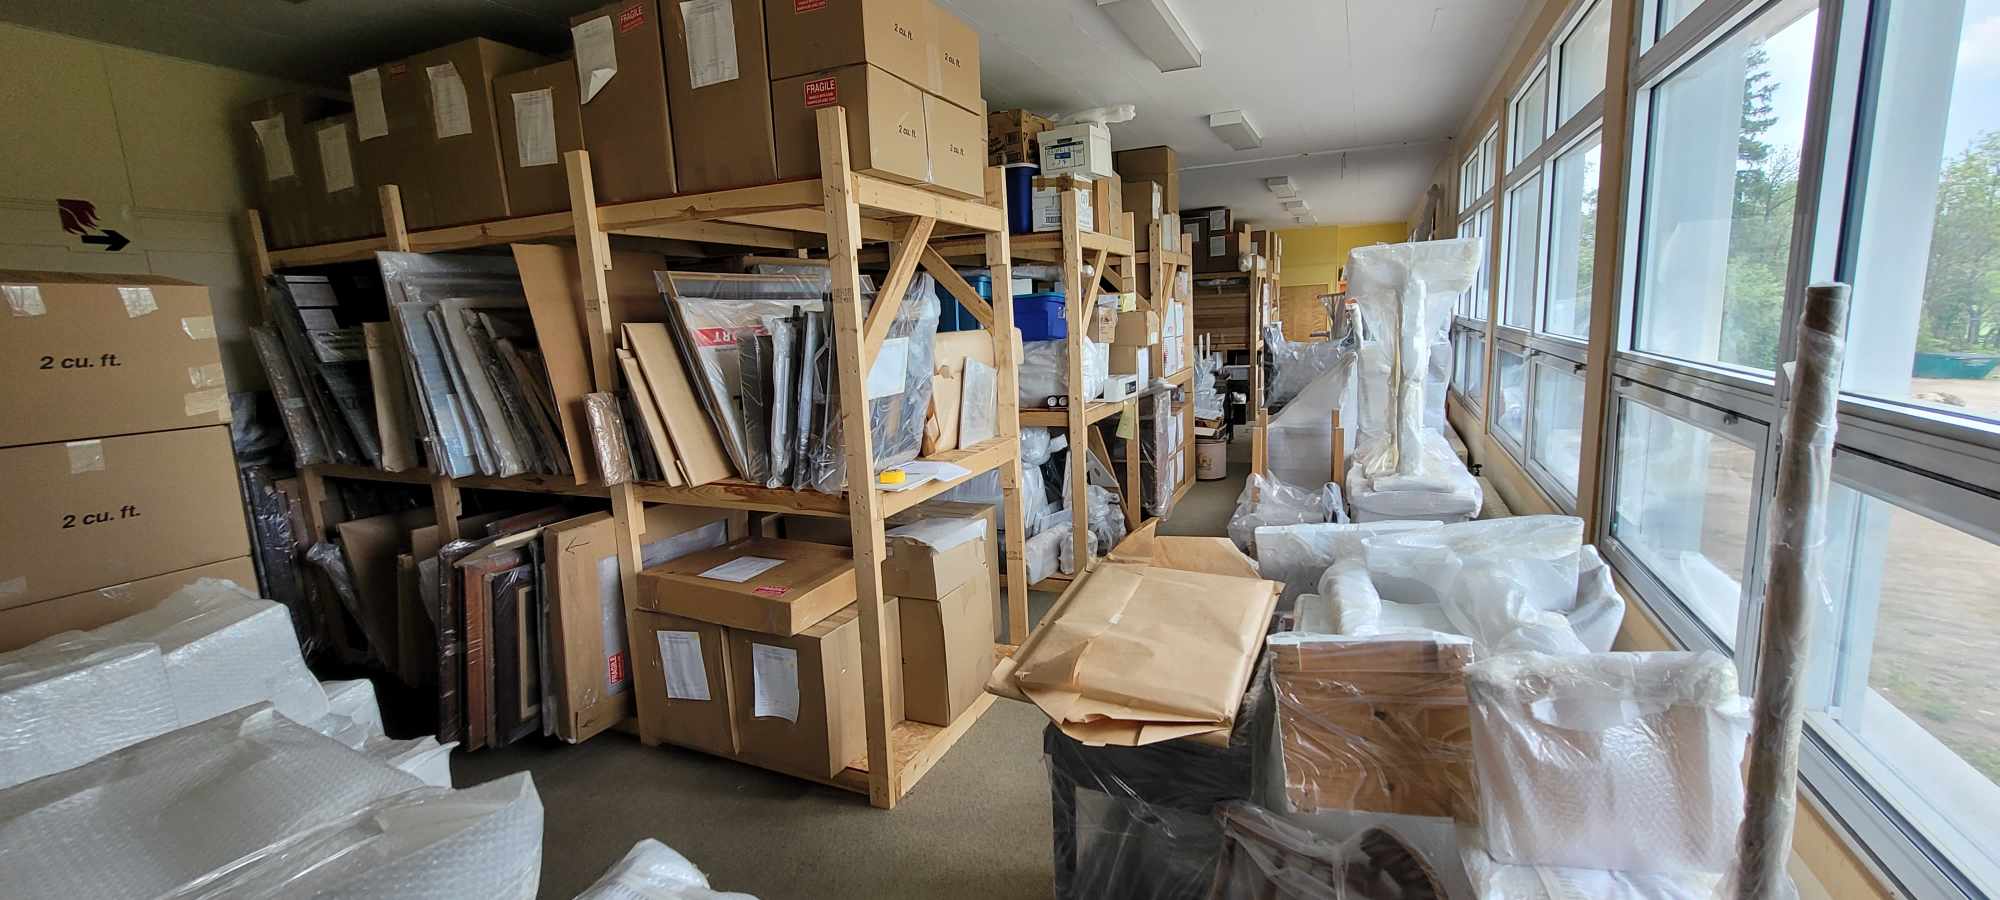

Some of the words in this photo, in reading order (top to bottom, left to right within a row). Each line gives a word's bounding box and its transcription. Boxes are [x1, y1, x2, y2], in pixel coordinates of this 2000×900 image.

[894, 23, 899, 33] 2
[806, 80, 835, 95] FRAGILE
[898, 124, 903, 134] 2
[39, 355, 54, 370] 2
[60, 357, 94, 369] cu.
[100, 353, 122, 368] ft.
[62, 514, 76, 529] 2
[83, 511, 115, 525] cu.
[120, 504, 141, 519] ft.
